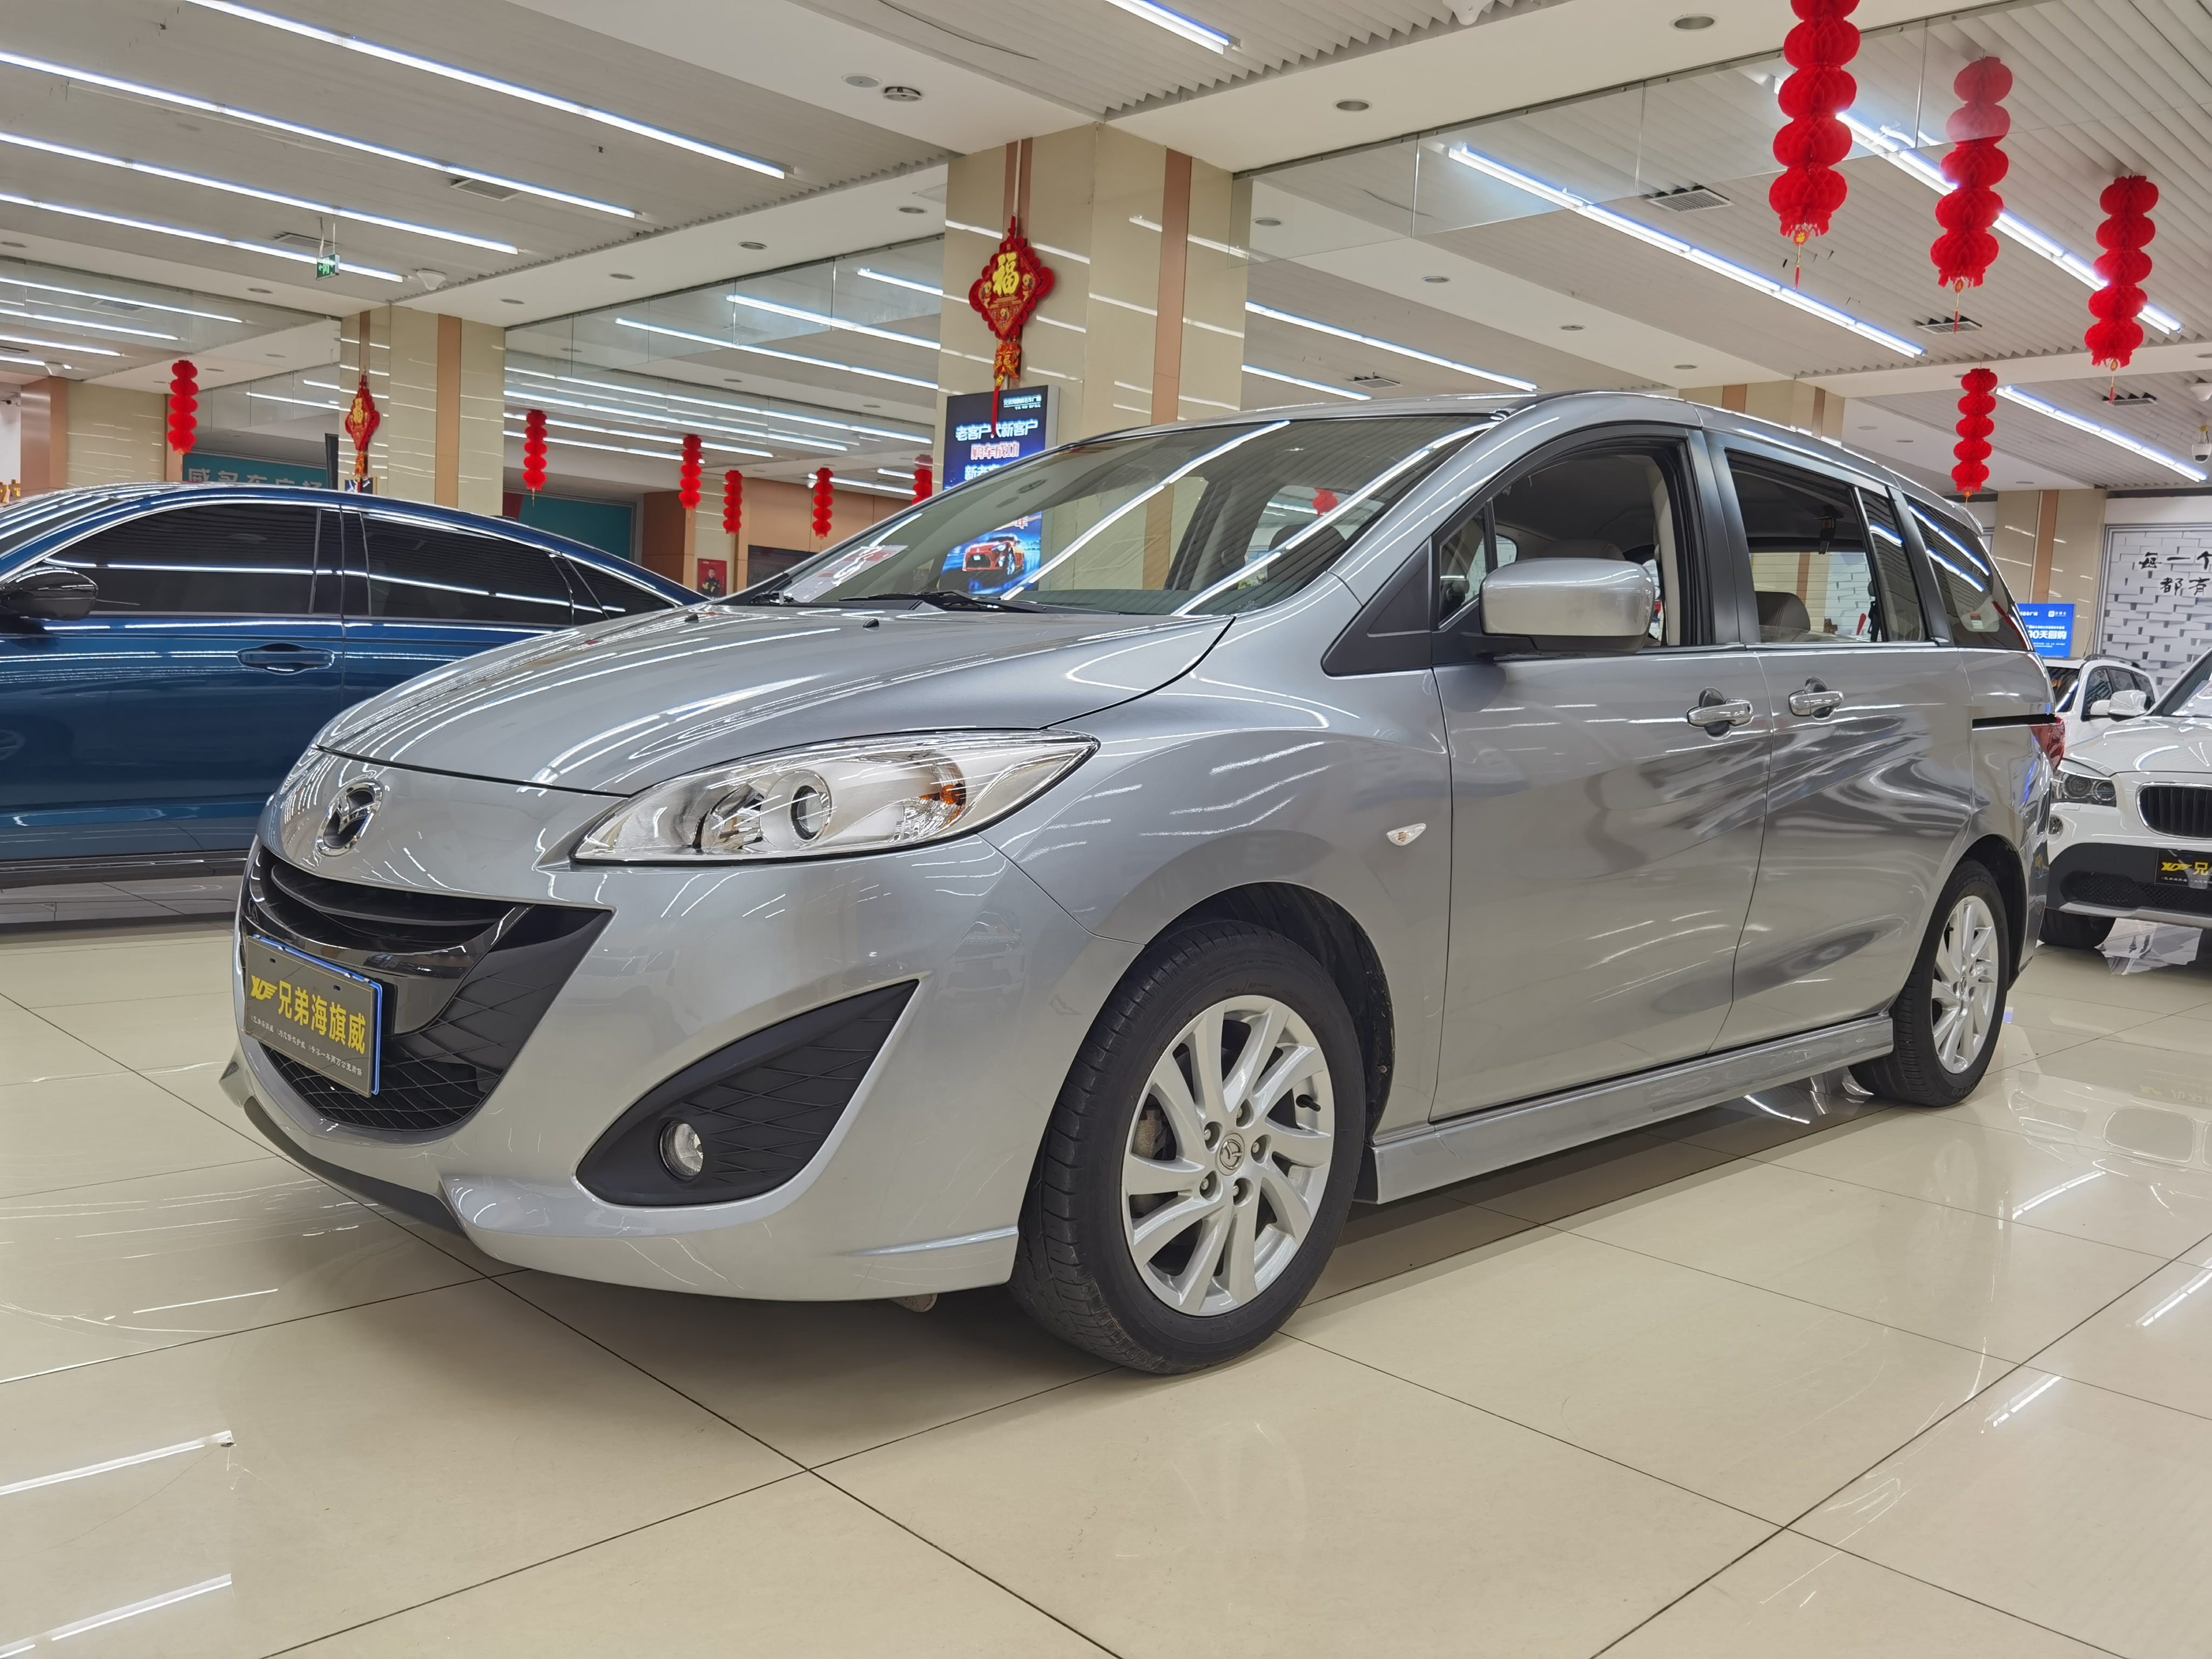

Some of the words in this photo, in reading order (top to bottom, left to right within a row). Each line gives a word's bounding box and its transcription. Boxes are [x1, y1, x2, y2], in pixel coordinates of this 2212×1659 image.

[992, 252, 1020, 296] 福
[970, 440, 1020, 460] 购车成功
[2139, 551, 2212, 570] 每一个
[2160, 577, 2210, 596] 都有
[278, 980, 366, 1055] 兄弟海旗威
